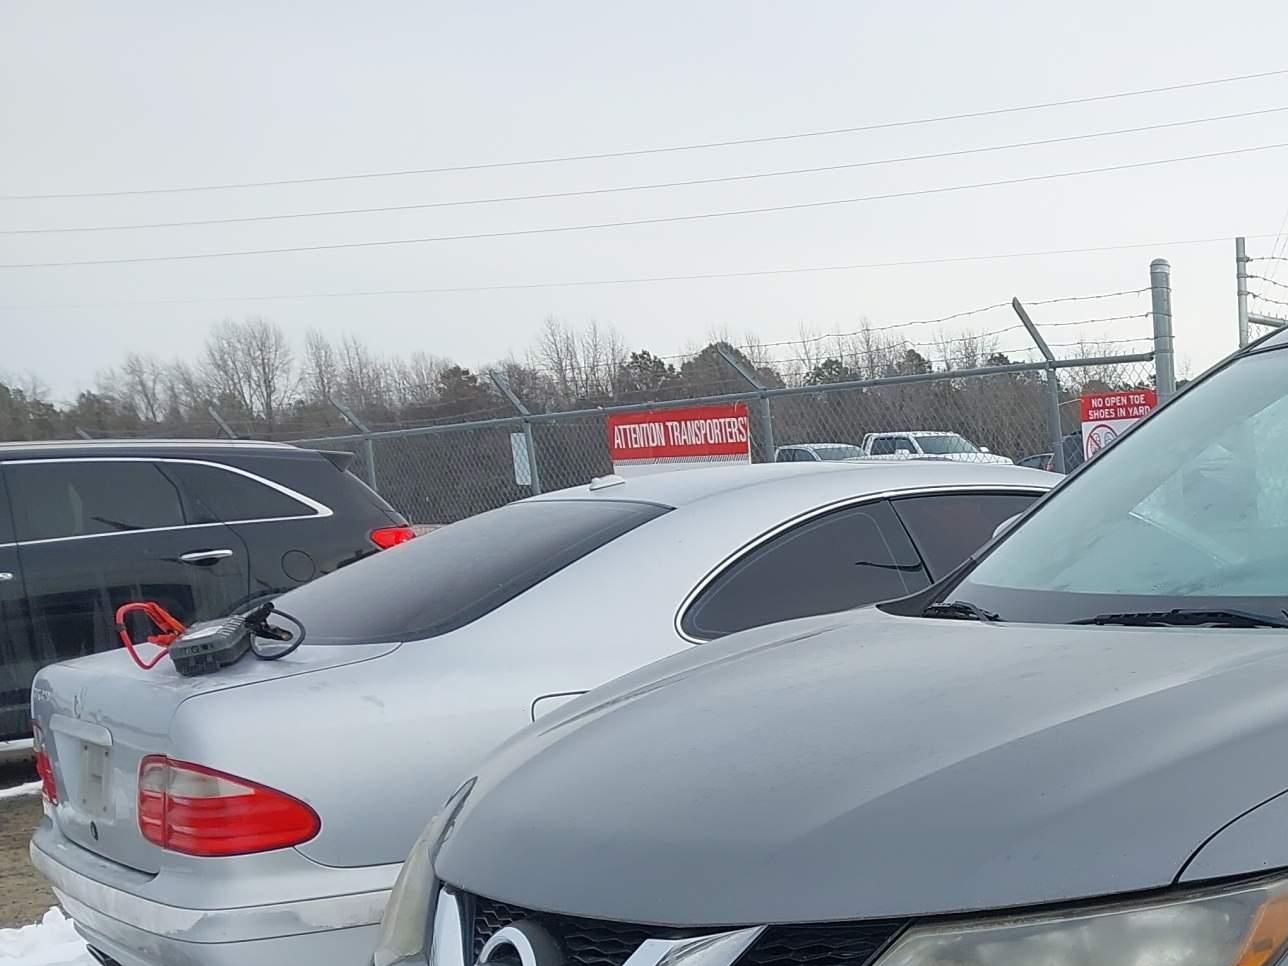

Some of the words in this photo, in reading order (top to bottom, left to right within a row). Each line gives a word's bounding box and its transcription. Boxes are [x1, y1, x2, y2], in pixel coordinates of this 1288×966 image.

[1091, 398, 1103, 408] NO
[1104, 395, 1127, 407] OPEN
[1128, 394, 1146, 405] TOE
[1088, 408, 1115, 420] SHOES
[1117, 407, 1126, 417] IN
[1127, 405, 1151, 416] YARD
[614, 422, 666, 449] ATTENTION
